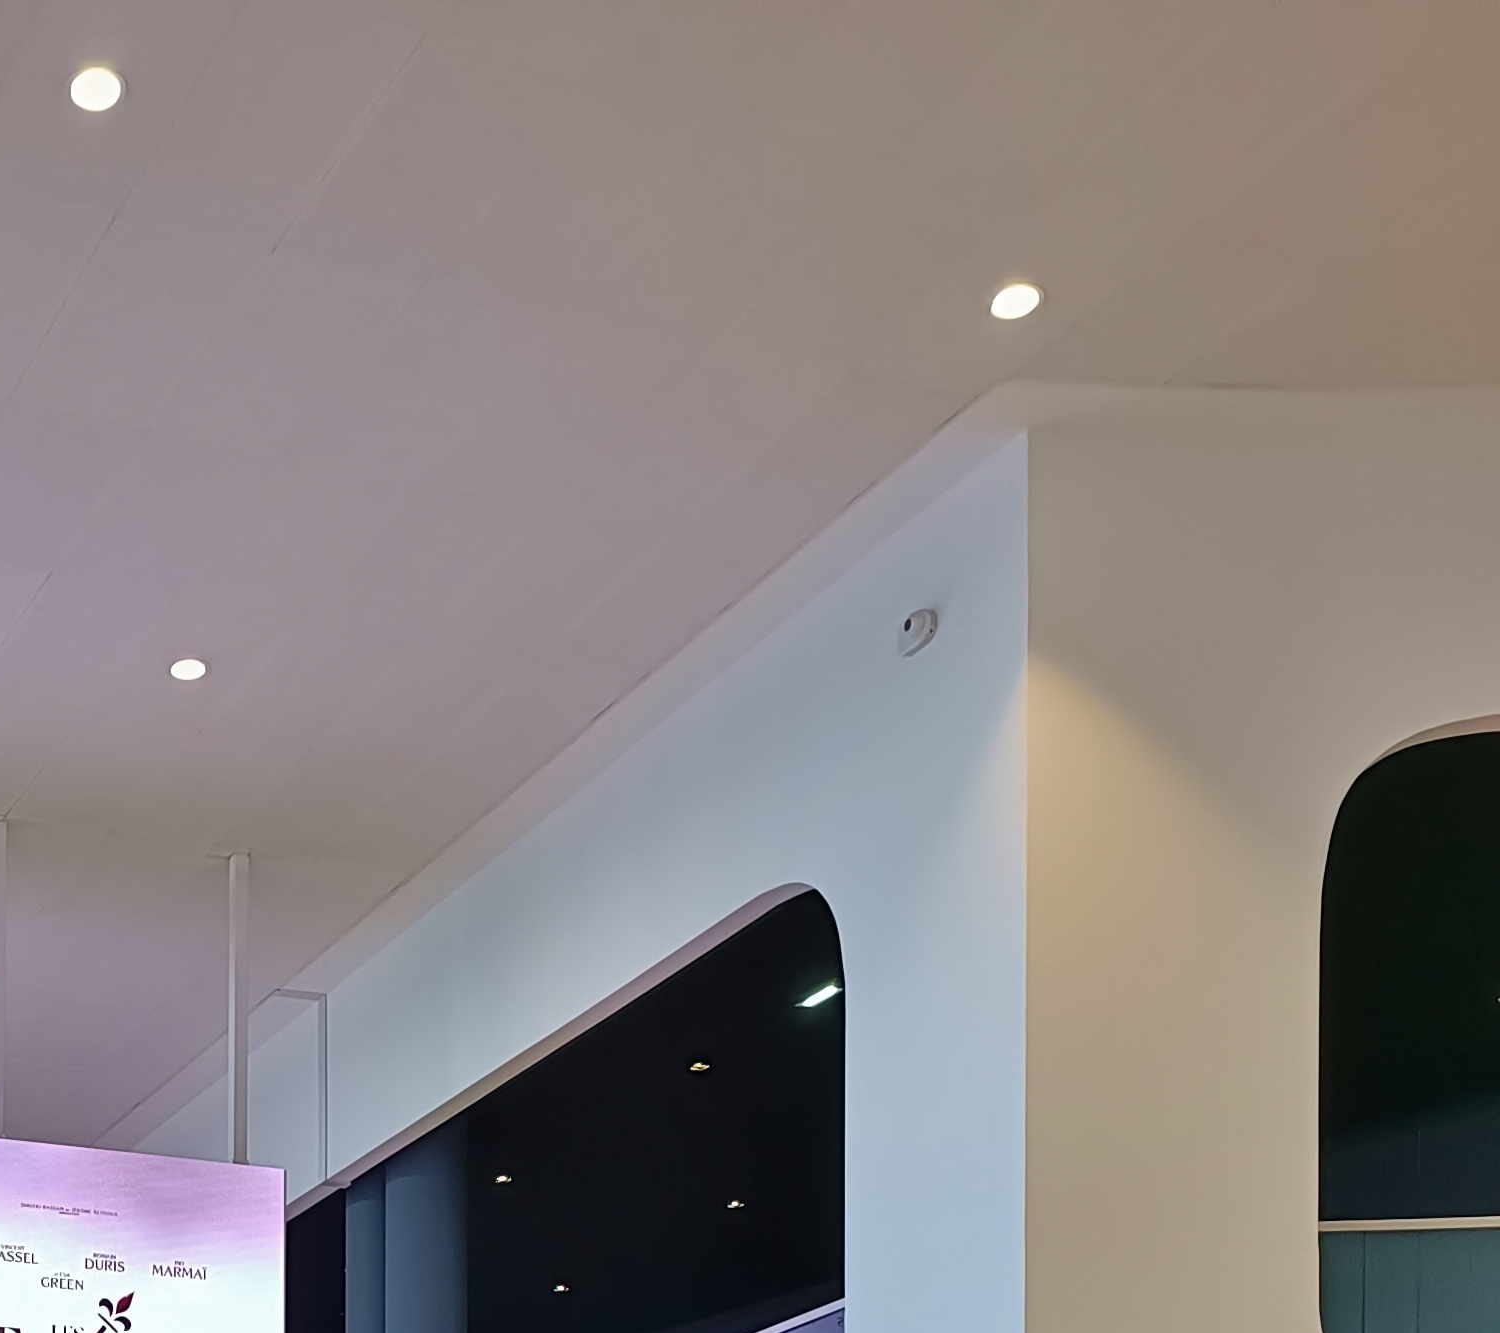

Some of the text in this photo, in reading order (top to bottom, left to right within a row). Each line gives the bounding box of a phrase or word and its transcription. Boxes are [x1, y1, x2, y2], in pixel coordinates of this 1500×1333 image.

[84, 1257, 126, 1273] DURIS
[152, 1264, 208, 1281] MARMAÏ
[40, 1276, 84, 1291] GREEN
